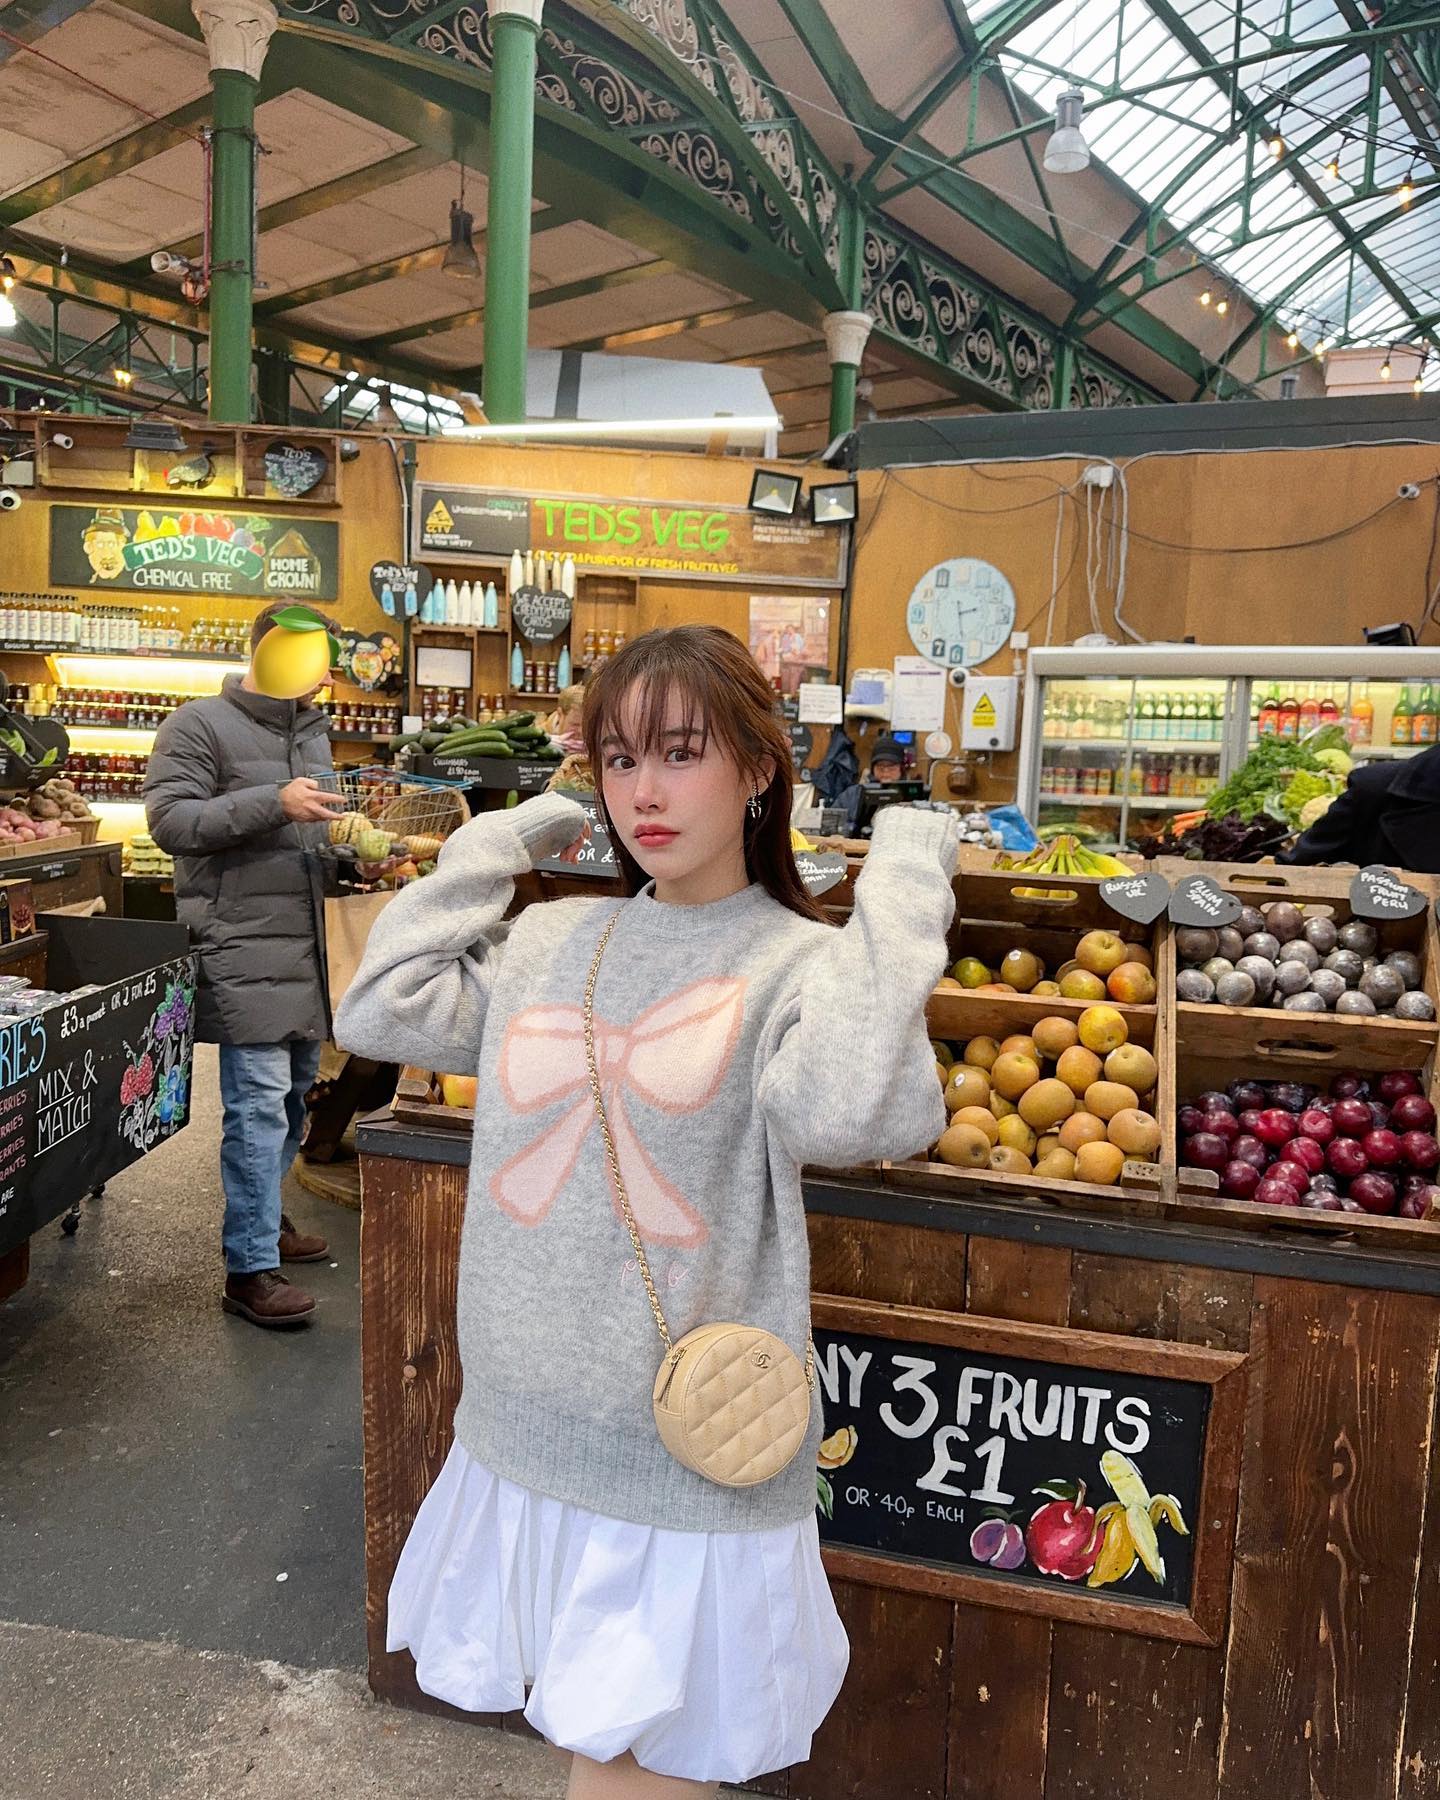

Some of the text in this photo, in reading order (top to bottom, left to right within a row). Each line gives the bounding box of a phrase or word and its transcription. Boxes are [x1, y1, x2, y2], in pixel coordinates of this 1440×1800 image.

[535, 499, 730, 552] TED'S VEG
[134, 535, 247, 567] TED'S VEG
[271, 558, 309, 572] HOME
[133, 568, 233, 591] CHEMICAL FREE
[1185, 889, 1220, 917] SPAIN
[1189, 880, 1223, 907] PLUM
[1370, 885, 1406, 901] FRUIT
[1372, 895, 1408, 910] PERU
[60, 1005, 79, 1038] £3
[111, 990, 121, 1010] OR
[131, 982, 143, 1001] FOR
[144, 971, 157, 996] £5
[39, 1049, 98, 1110] MIX &
[38, 1091, 91, 1152] MATCH
[879, 1355, 939, 1439] 3
[957, 1366, 1151, 1453] FRUITS
[916, 1425, 1015, 1505] £1
[846, 1486, 869, 1507] OR
[926, 1500, 964, 1524] EACH
